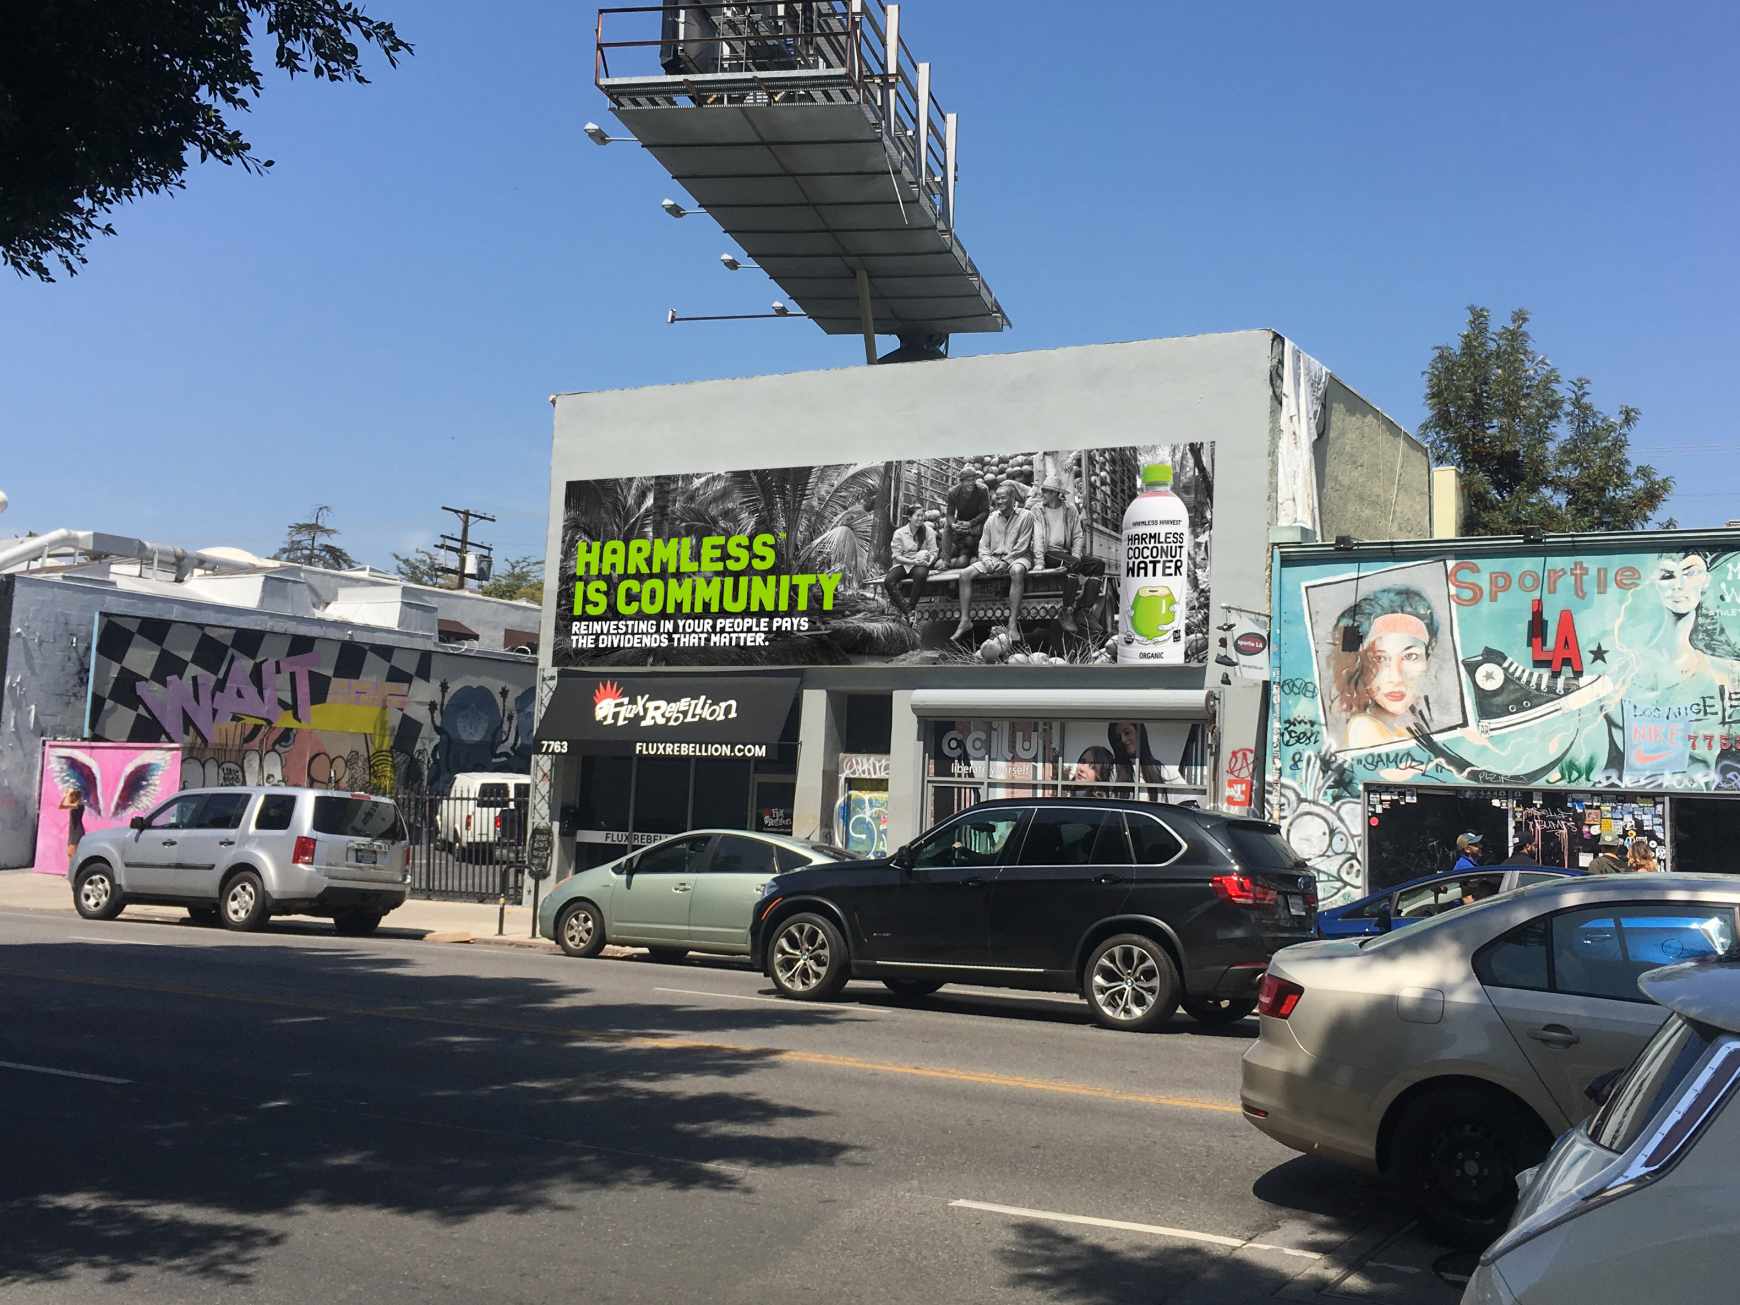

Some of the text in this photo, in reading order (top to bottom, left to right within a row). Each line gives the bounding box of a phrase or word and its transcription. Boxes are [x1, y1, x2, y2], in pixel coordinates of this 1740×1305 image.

[1127, 531, 1184, 547] HARMLESS
[575, 533, 776, 576] HARMLESS
[1127, 545, 1183, 560] COCONUT
[1126, 560, 1183, 578] WATER
[573, 573, 842, 616] IS COMMUNITY
[571, 617, 809, 634] REINVESTING IN YOUR PEOPLE PAYS
[571, 632, 769, 648] THE DIVIDENDS THAT MATTER.
[1530, 598, 1584, 678] LA
[1138, 651, 1164, 660] ORGANIC
[541, 741, 766, 757] 7763 FLUXREBELLION.COM
[604, 832, 631, 843] FLUX
